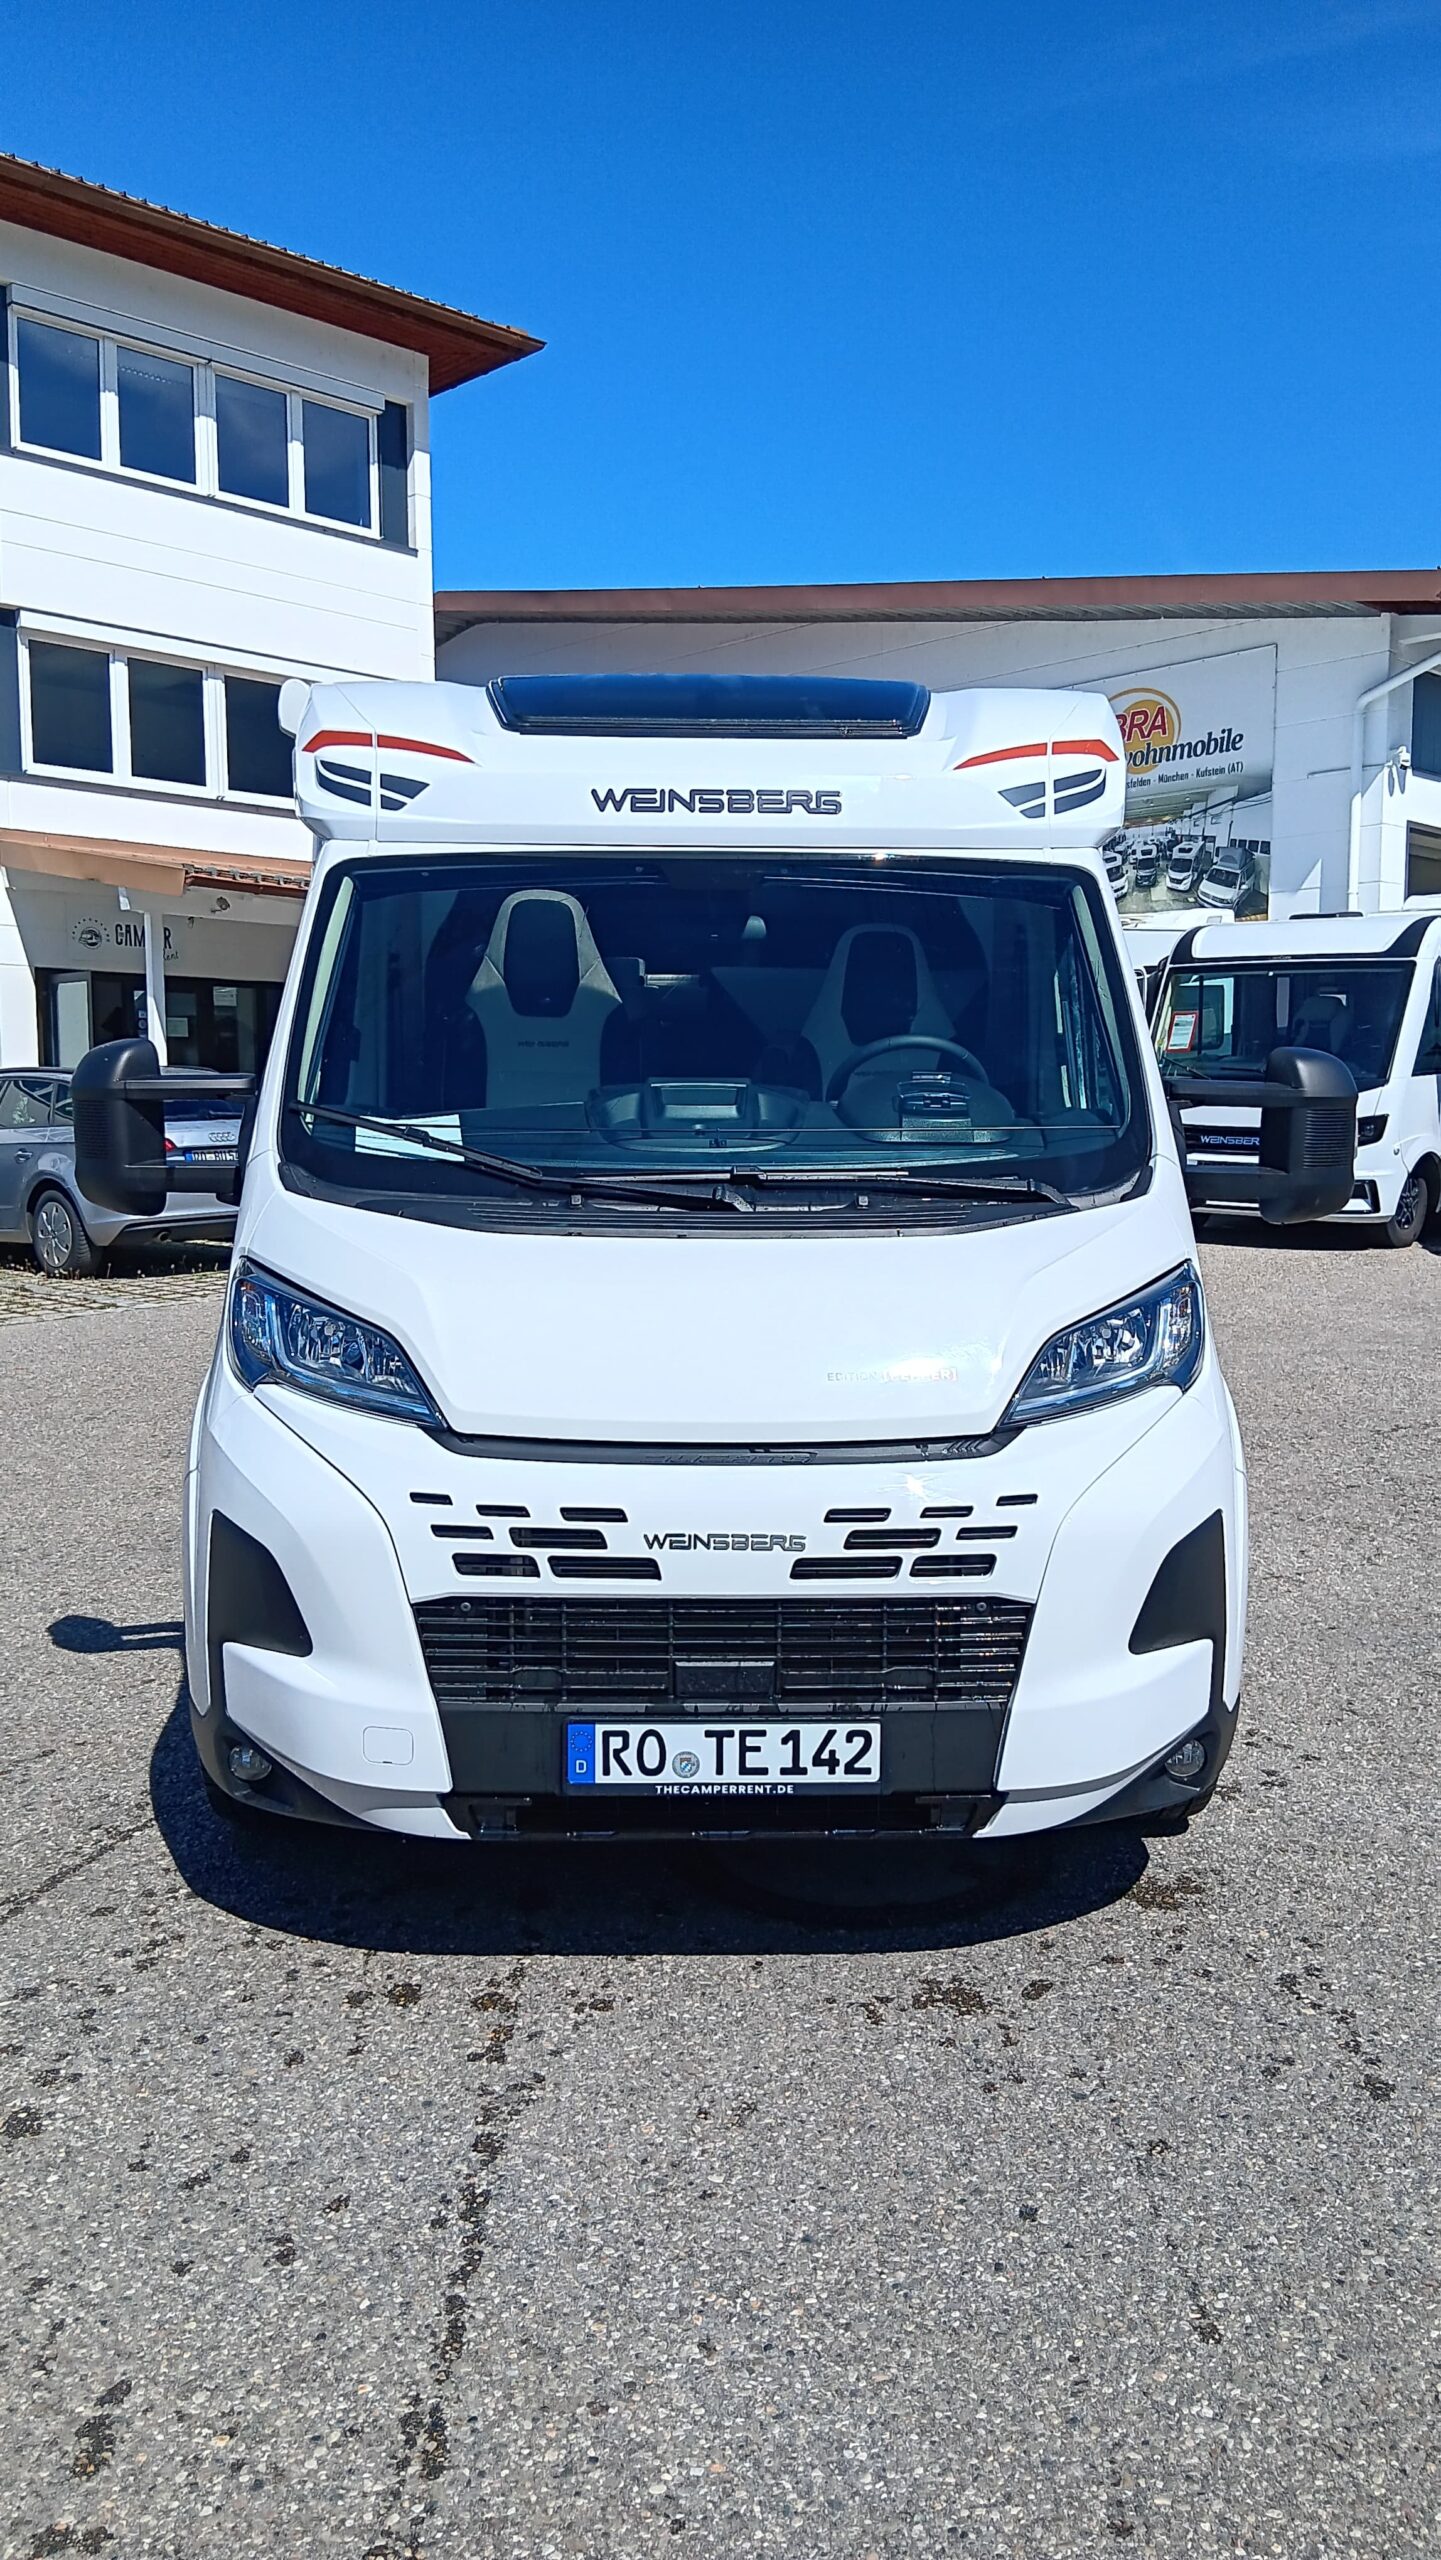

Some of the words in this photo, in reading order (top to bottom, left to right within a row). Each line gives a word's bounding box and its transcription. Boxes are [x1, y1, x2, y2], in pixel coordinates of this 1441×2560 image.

[1115, 705, 1168, 742] BRA
[1126, 777, 1152, 789] sfelden
[1158, 772, 1189, 784] München
[1195, 765, 1226, 778] Kufstein
[1227, 760, 1244, 774] (AT)
[591, 788, 842, 814] WEINSBERG
[115, 923, 172, 949] CAMR
[1200, 1135, 1260, 1146] WEINSBER
[643, 1533, 807, 1552] WEINSBERG
[575, 1760, 587, 1773] D
[602, 1729, 667, 1777] RO
[704, 1729, 769, 1776] TE
[779, 1729, 873, 1776] 142
[655, 1784, 794, 1795] THECAMPERRENT.DE
